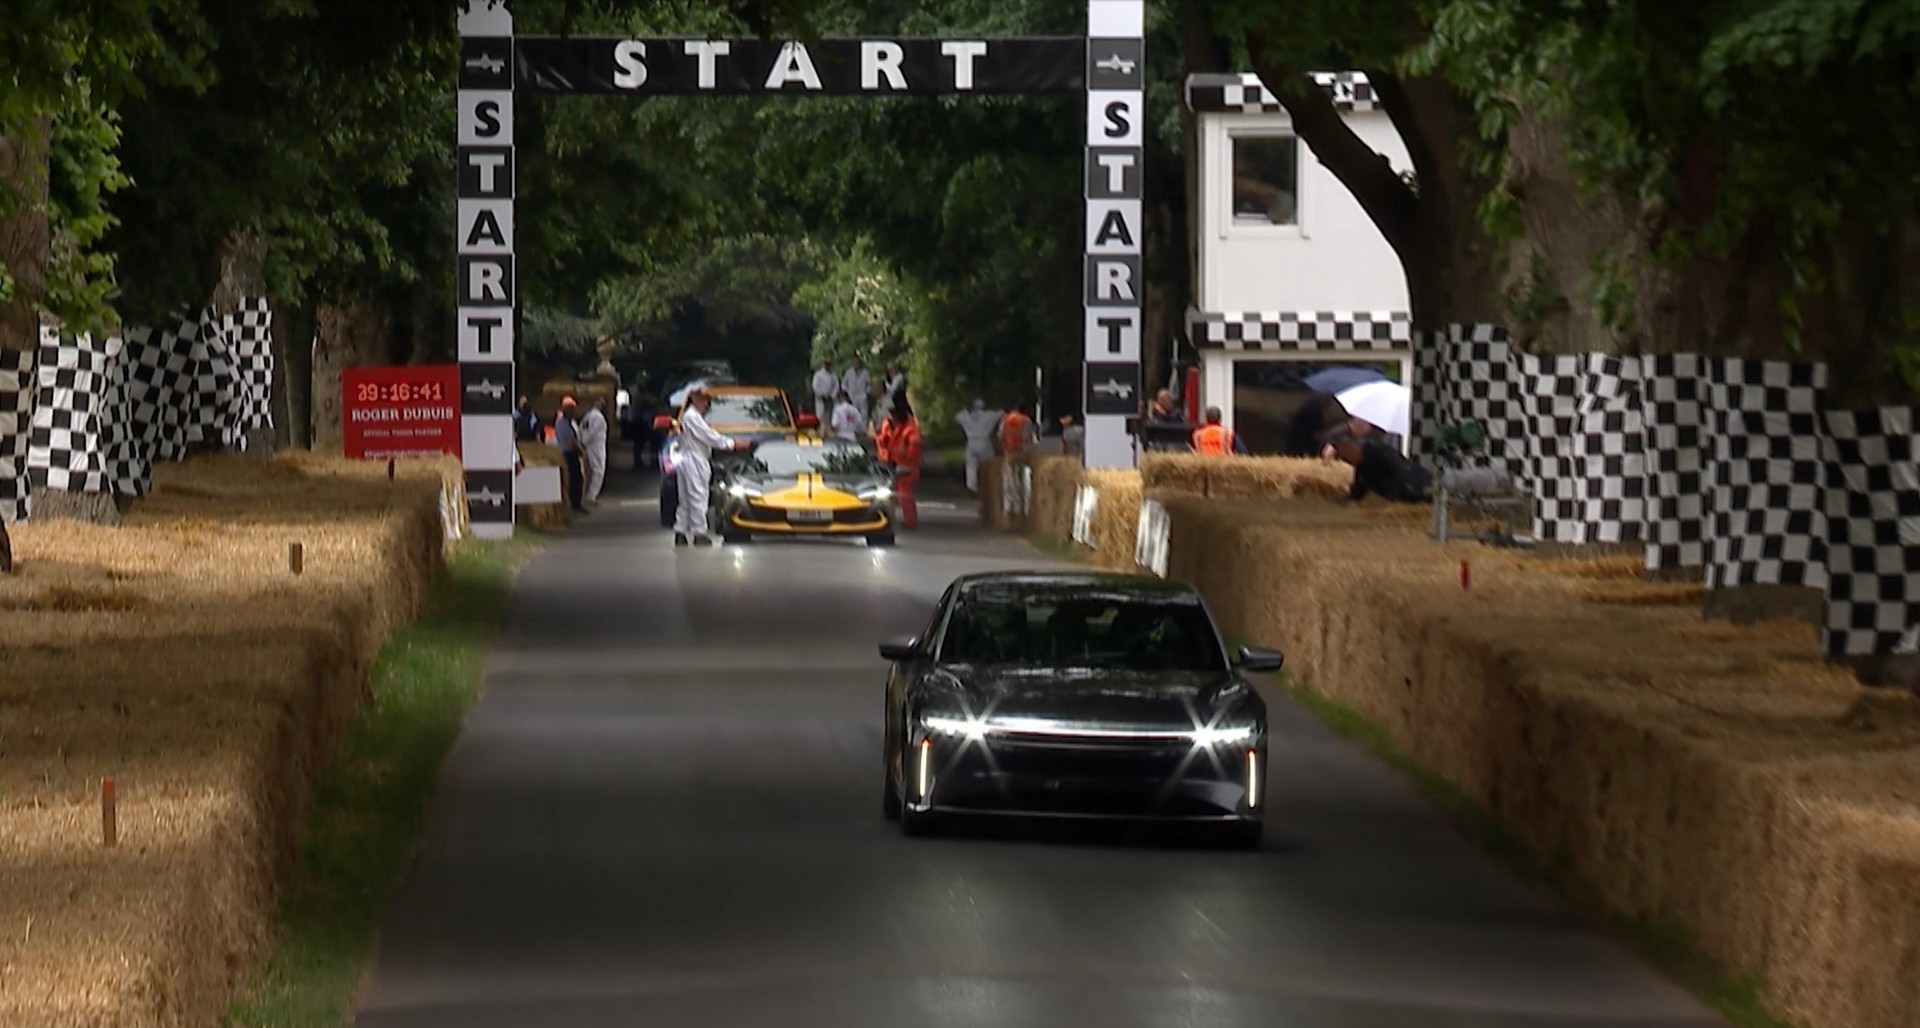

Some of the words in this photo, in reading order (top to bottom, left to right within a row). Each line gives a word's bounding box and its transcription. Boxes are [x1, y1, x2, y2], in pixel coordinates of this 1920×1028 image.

[614, 40, 987, 90] START
[466, 101, 508, 353] START
[1094, 101, 1135, 353] START
[352, 407, 400, 421] ROGER
[403, 406, 454, 420] DUBUIS
